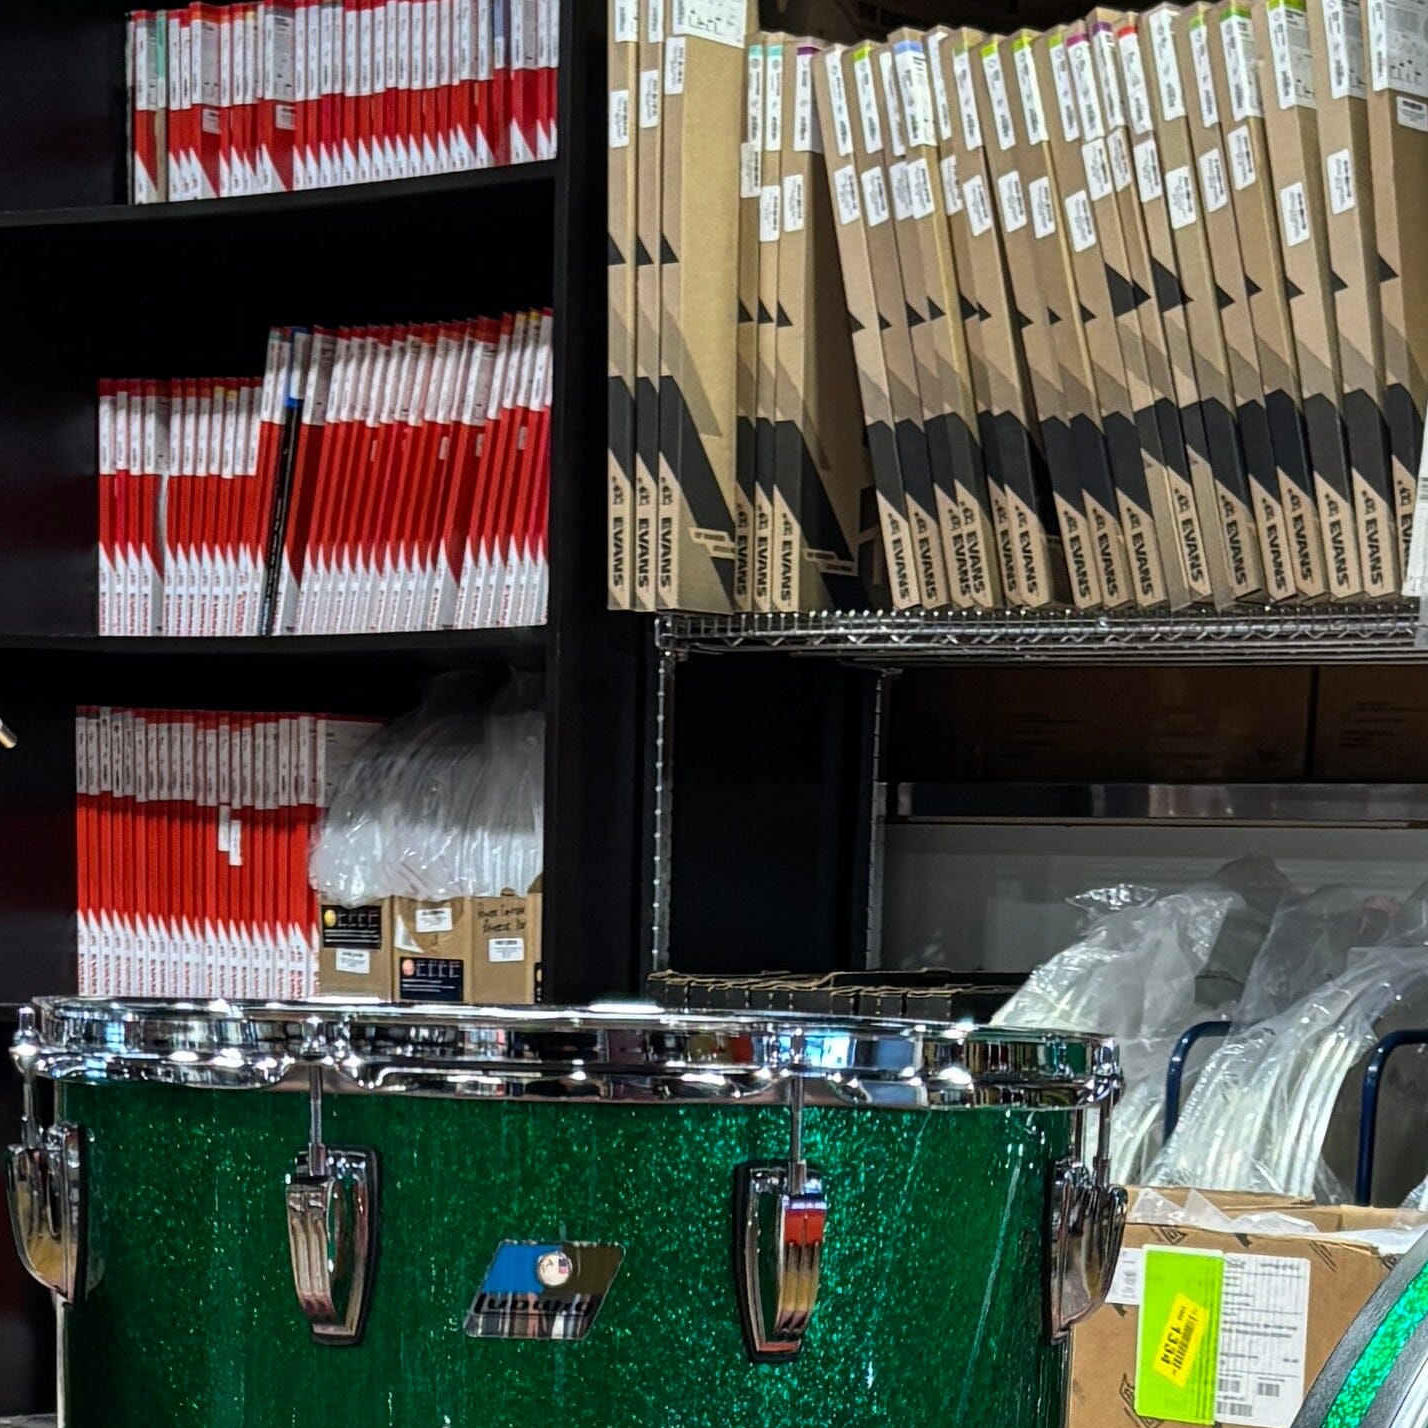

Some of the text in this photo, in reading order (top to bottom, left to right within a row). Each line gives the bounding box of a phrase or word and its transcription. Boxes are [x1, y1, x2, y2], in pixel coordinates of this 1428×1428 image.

[613, 517, 623, 587] EVANS
[638, 518, 650, 588] EVANS
[660, 517, 671, 587] EVANS
[736, 535, 748, 597] EVANS
[757, 536, 768, 598] EVANS
[781, 540, 792, 601] EVANS
[892, 538, 909, 599] EVANS
[918, 537, 937, 598] EVANS
[952, 534, 971, 596] EVANS
[966, 531, 986, 594] EVANS
[999, 529, 1017, 593] EVANS
[1019, 531, 1037, 594] EVANS
[1069, 535, 1091, 598] EVANS
[1098, 534, 1118, 596] EVANS
[1132, 533, 1154, 596] EVANS
[1182, 518, 1204, 582] EVANS
[1226, 522, 1247, 586] EVANS
[1267, 524, 1289, 592] EVANS
[1292, 514, 1312, 581] EVANS
[1329, 519, 1349, 588] EVANS
[1365, 519, 1383, 588] EVANS
